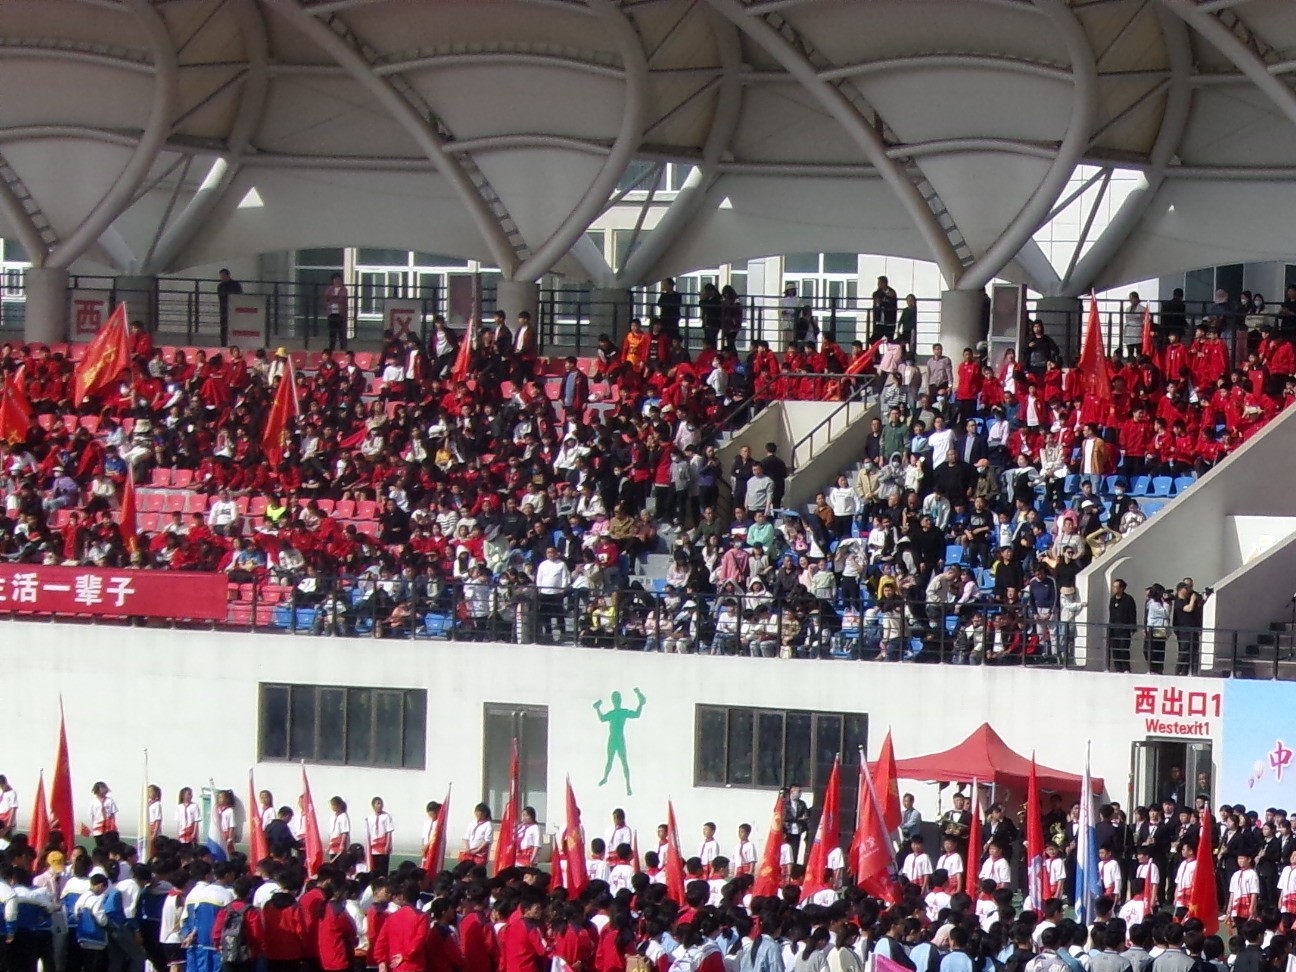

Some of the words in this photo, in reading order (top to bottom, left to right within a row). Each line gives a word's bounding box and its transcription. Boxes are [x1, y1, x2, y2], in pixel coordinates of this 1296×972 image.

[75, 299, 104, 335] 西
[0, 572, 135, 606] 活一辈子
[1134, 687, 1221, 717] 西出口1
[1145, 718, 1210, 735] Westexit1
